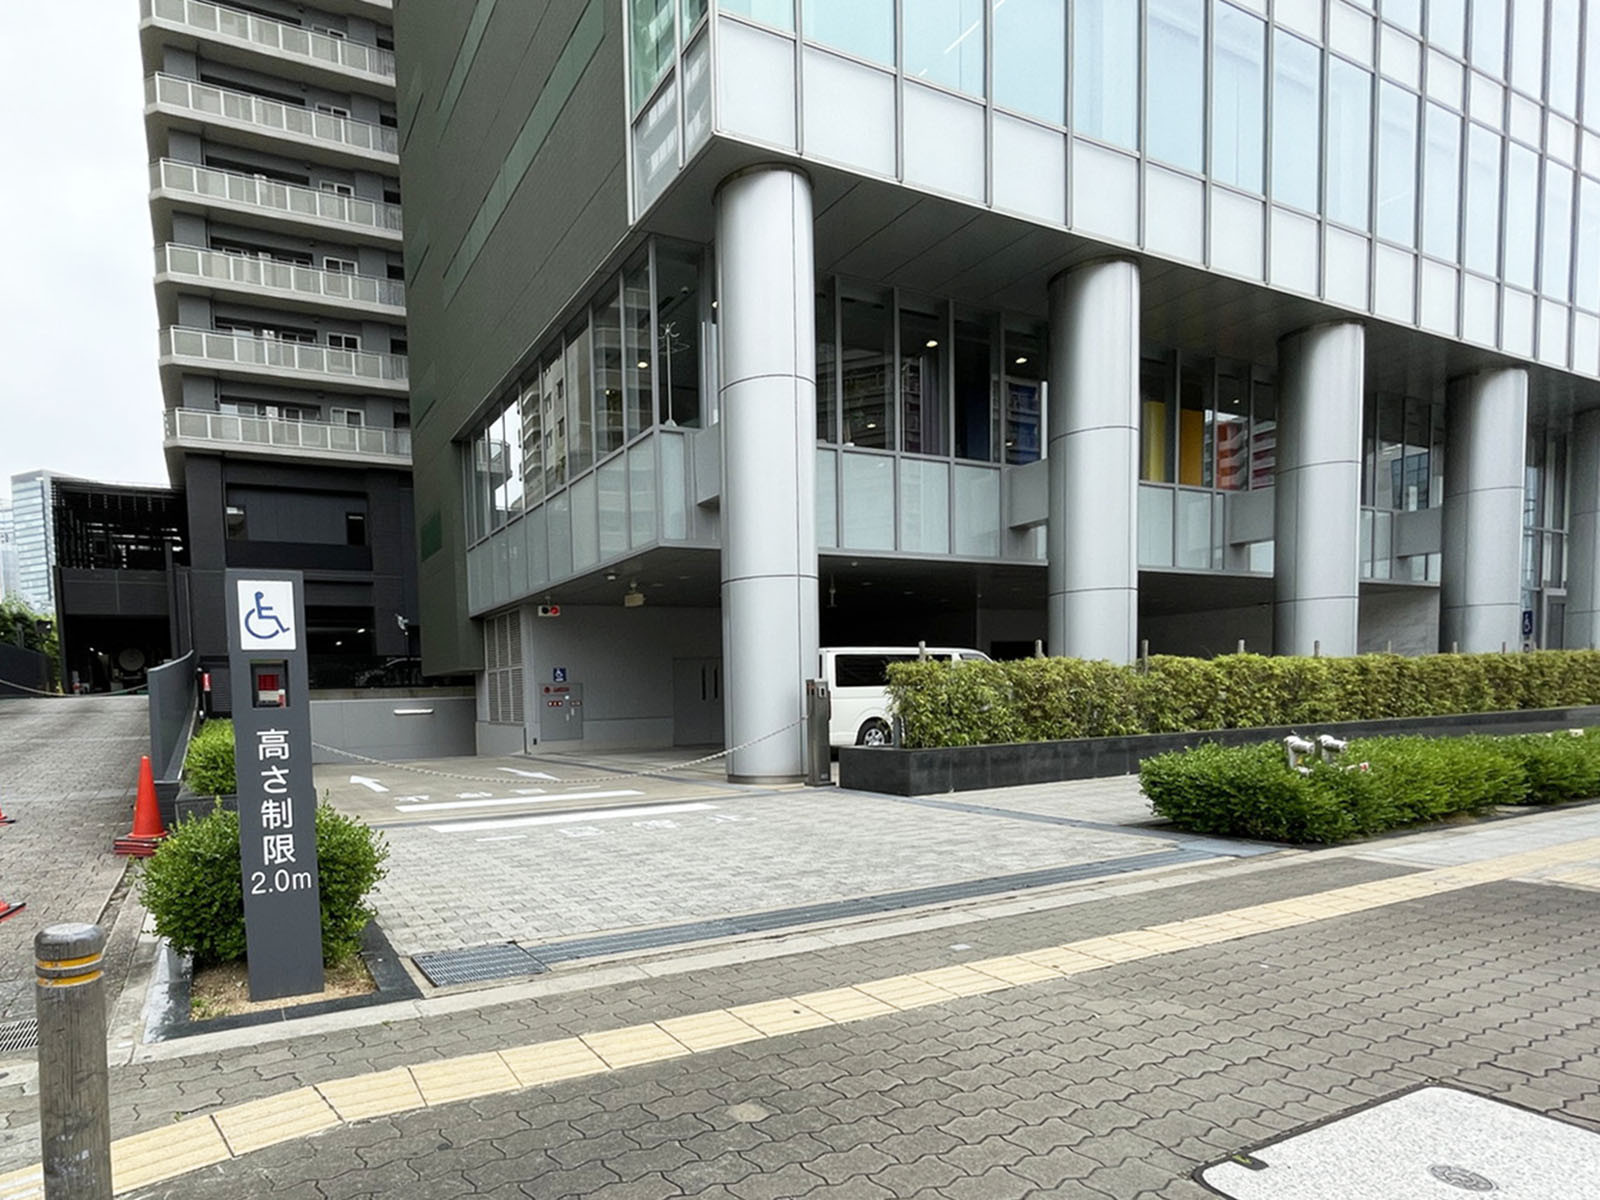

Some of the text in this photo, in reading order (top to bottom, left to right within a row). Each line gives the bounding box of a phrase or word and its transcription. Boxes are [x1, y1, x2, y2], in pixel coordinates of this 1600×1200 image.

[256, 728, 297, 866] 高さ制限
[251, 869, 312, 895] 2.0m
